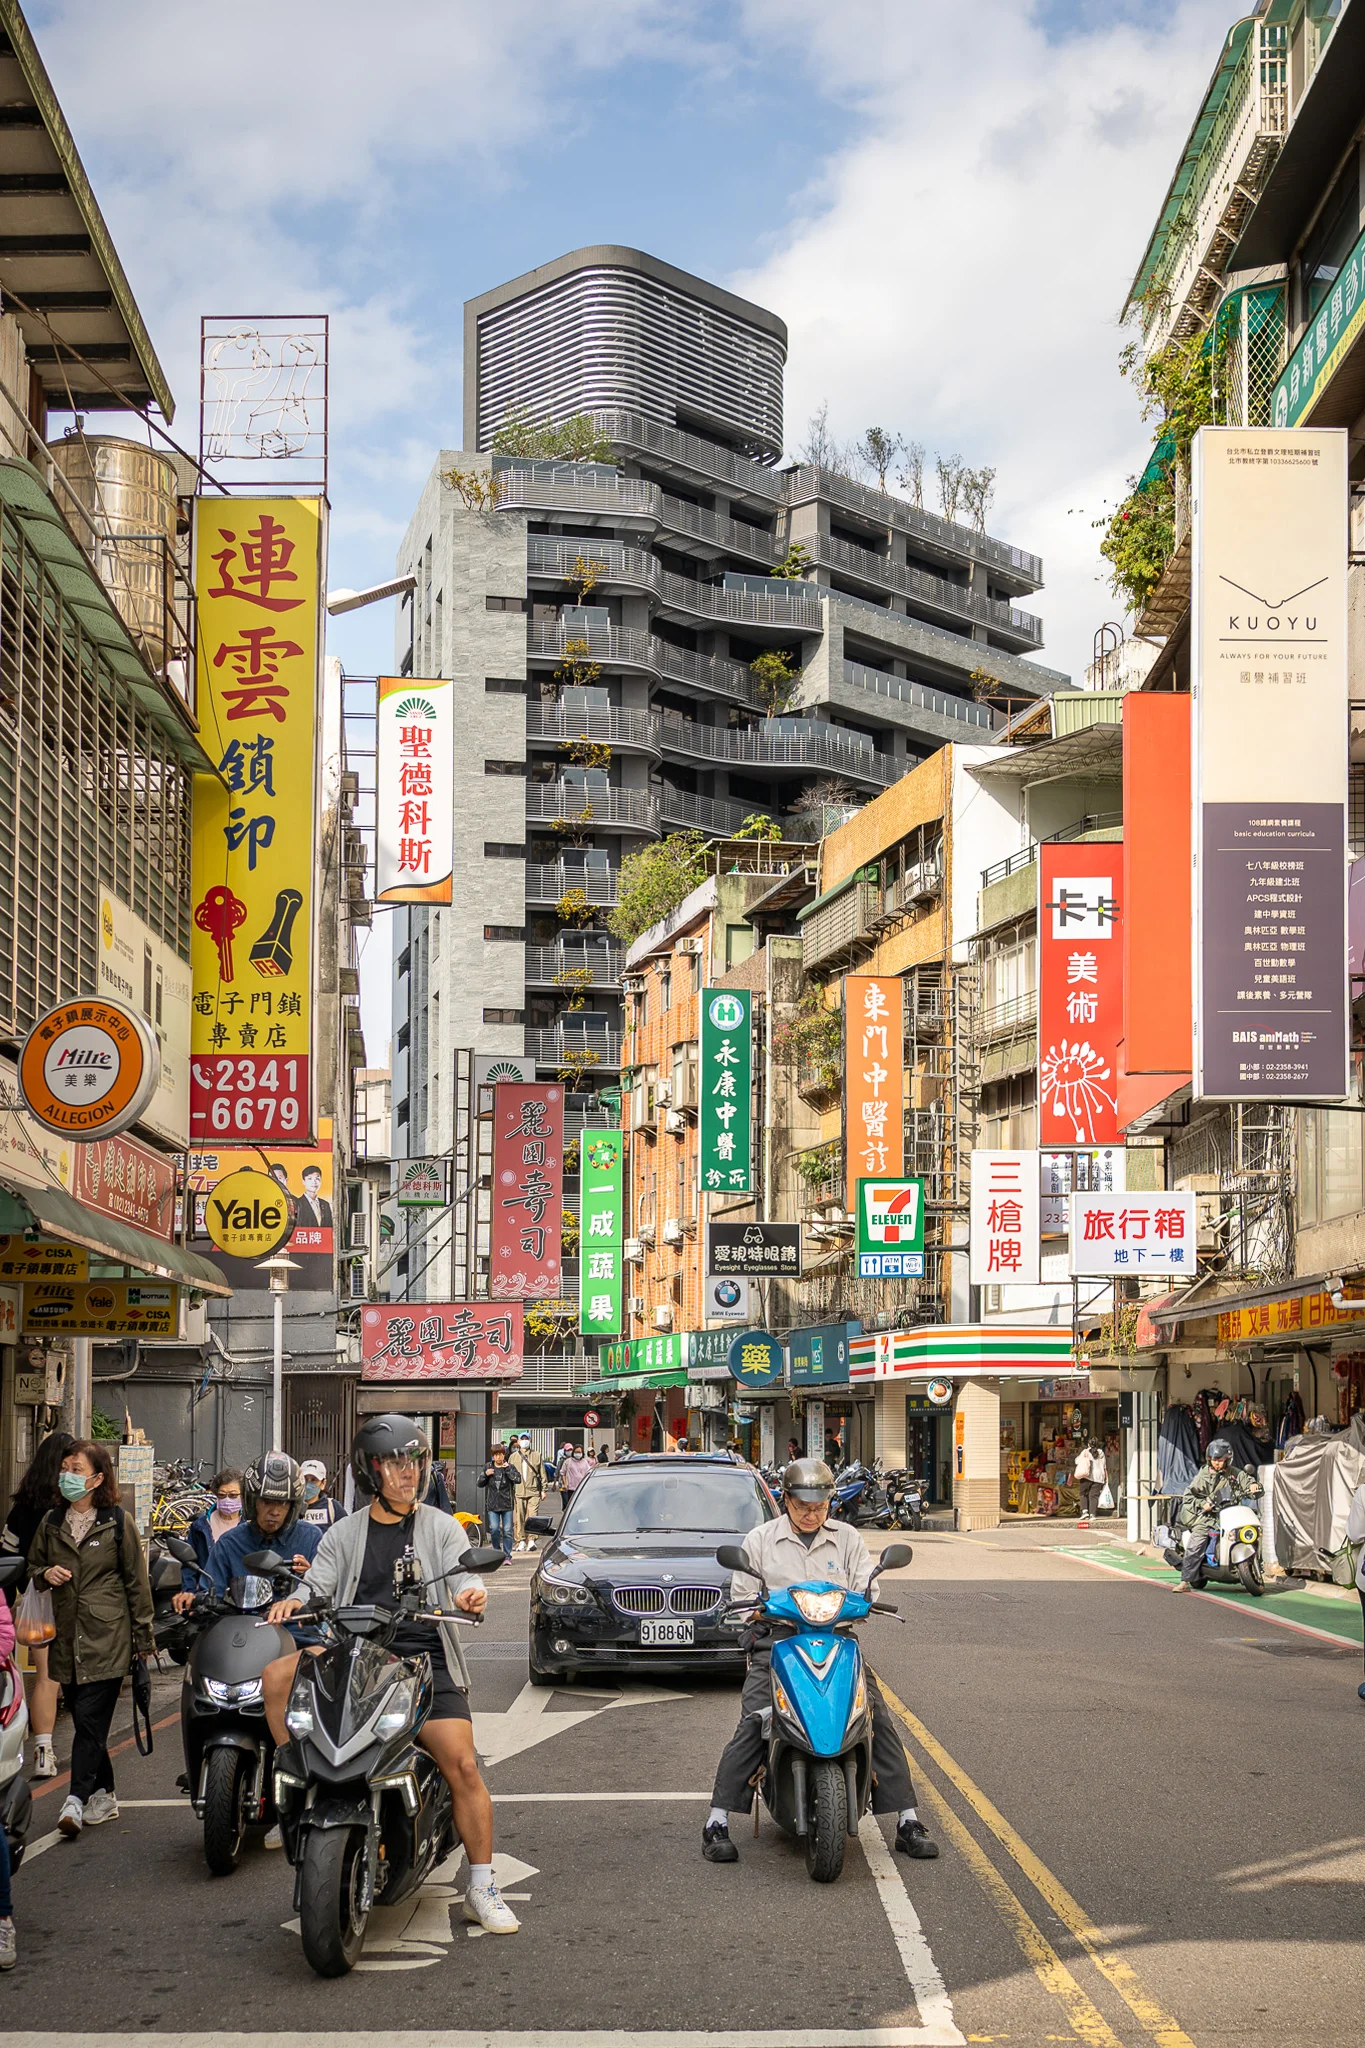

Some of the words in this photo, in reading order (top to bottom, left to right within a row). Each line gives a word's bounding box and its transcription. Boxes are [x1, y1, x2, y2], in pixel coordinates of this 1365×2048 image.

[1229, 616, 1317, 630] KUOYU
[1240, 671, 1307, 685] 國譽補習班
[397, 725, 433, 873] 聖德科斯
[1246, 893, 1303, 903] APCS程式設計
[1066, 951, 1099, 1025] 美術
[193, 991, 302, 1017] 電子門鎖
[40, 1008, 130, 1041] 電子鎖展示中心
[208, 1022, 288, 1048] 專賣店
[1232, 1031, 1258, 1043] BAIS
[1259, 1031, 1299, 1043] aniMath
[65, 1073, 97, 1087] 美樂
[216, 1059, 298, 1092] 2341
[43, 1100, 115, 1124] ALLEGION
[212, 1200, 281, 1230] Yale
[986, 1160, 1024, 1274] 三槍牌
[1083, 1208, 1186, 1241] 旅行箱
[45, 1249, 73, 1258] CISA
[588, 1184, 616, 1323] 一成蔬果
[714, 1245, 797, 1262] 愛視特眼鏡
[1114, 1248, 1185, 1263] 地下一樓
[714, 1264, 741, 1272] Eyesight
[743, 1264, 778, 1272] Eyeglasses
[34, 1305, 69, 1313] SAMSUNG
[89, 1297, 113, 1308] Yale
[145, 1311, 171, 1319] CISA
[741, 1343, 771, 1375] 藥
